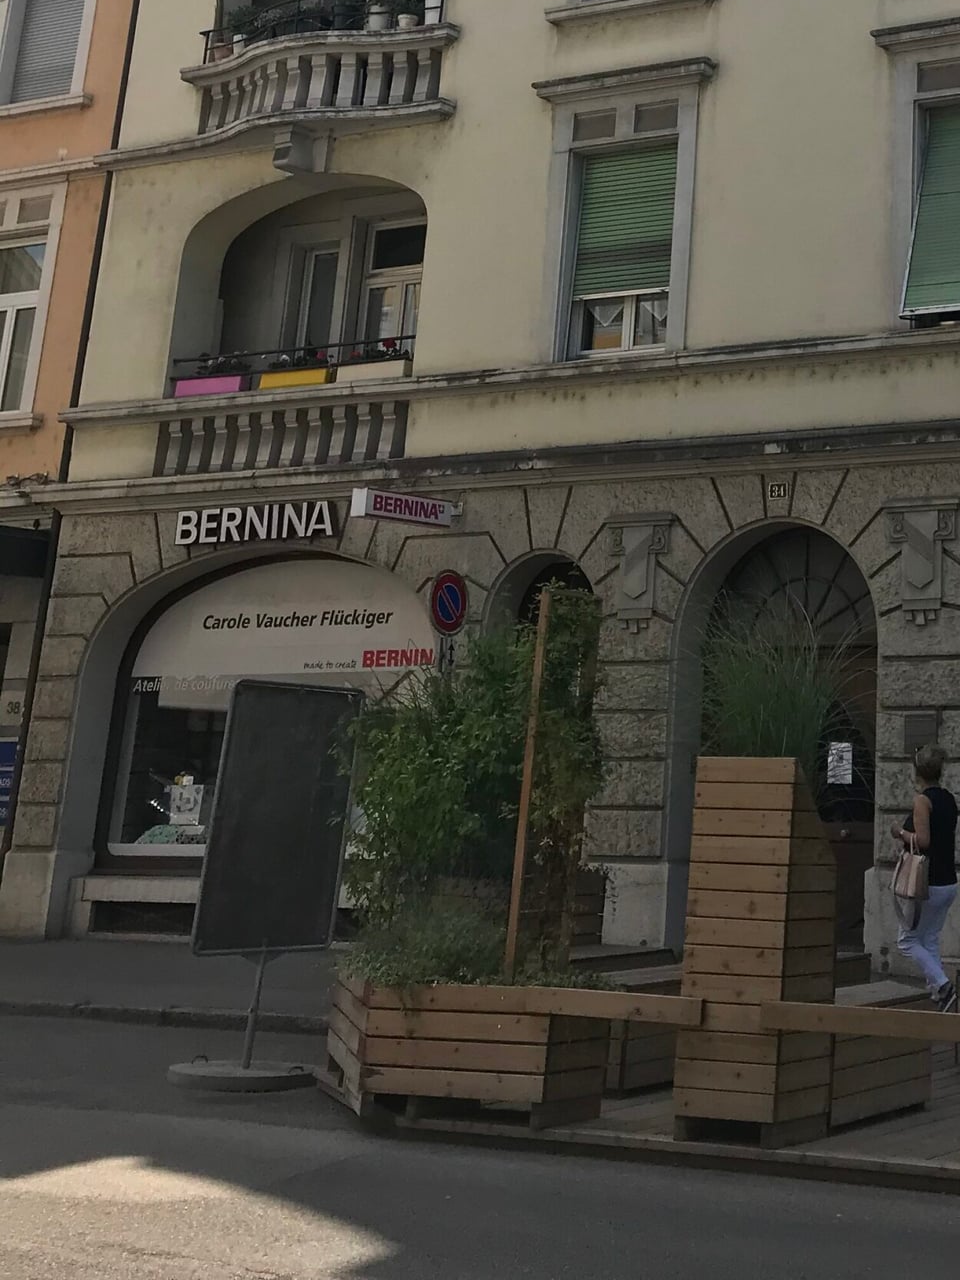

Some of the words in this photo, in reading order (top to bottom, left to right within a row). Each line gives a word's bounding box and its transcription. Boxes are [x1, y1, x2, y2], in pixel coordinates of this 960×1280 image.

[373, 494, 439, 519] BERNINA
[175, 500, 333, 545] BERNINA
[202, 614, 251, 630] Carole
[256, 611, 317, 629] Vaucher
[320, 609, 394, 629] Flückiger
[362, 648, 436, 668] BERNIN
[7, 701, 20, 714] 38
